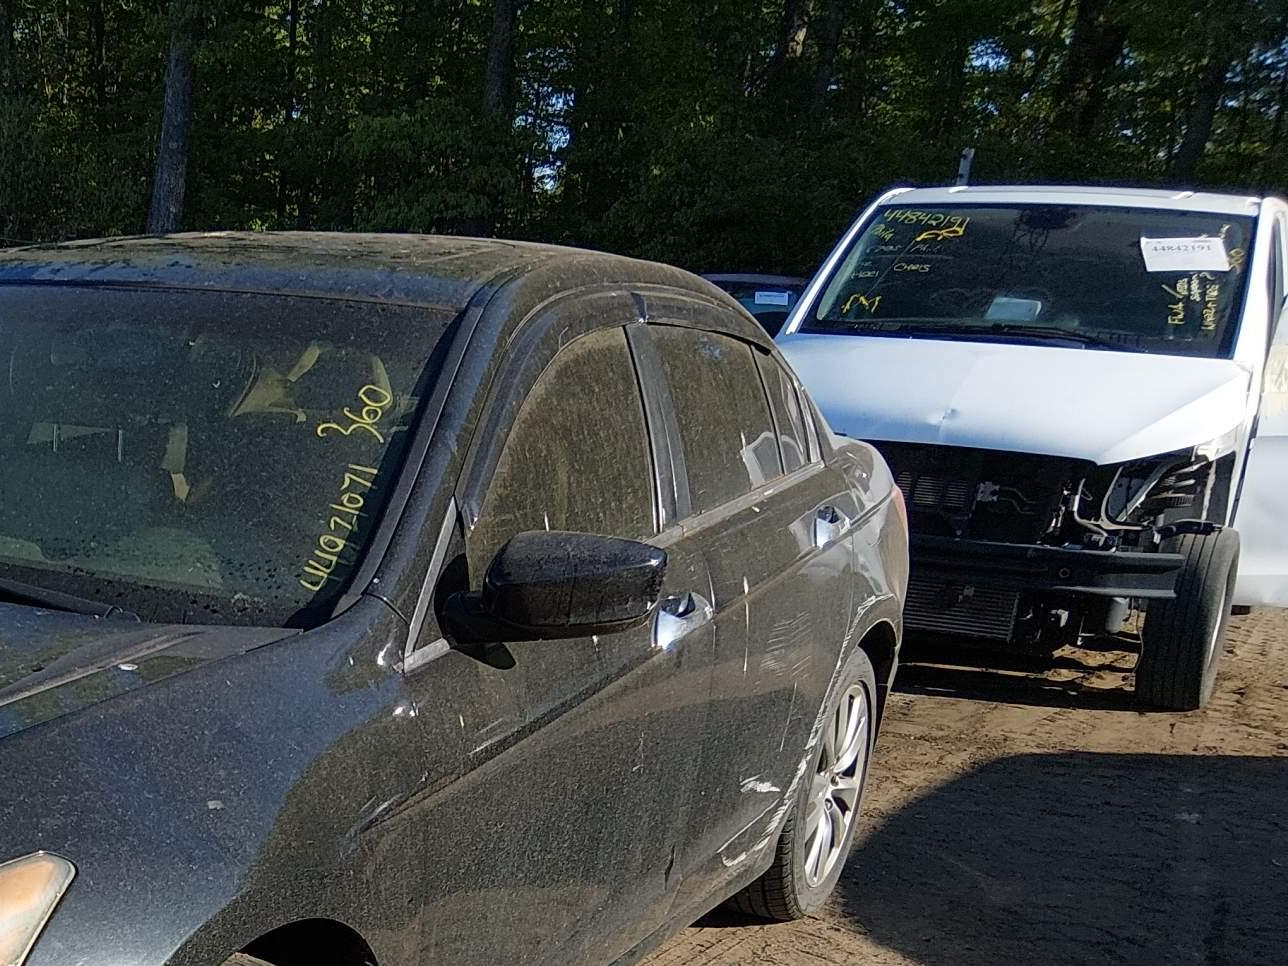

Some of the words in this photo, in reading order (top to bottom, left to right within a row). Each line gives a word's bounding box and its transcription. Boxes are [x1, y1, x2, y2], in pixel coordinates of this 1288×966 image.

[883, 208, 970, 232] 44842191
[316, 384, 392, 444] 360
[299, 462, 379, 592] 44921071
